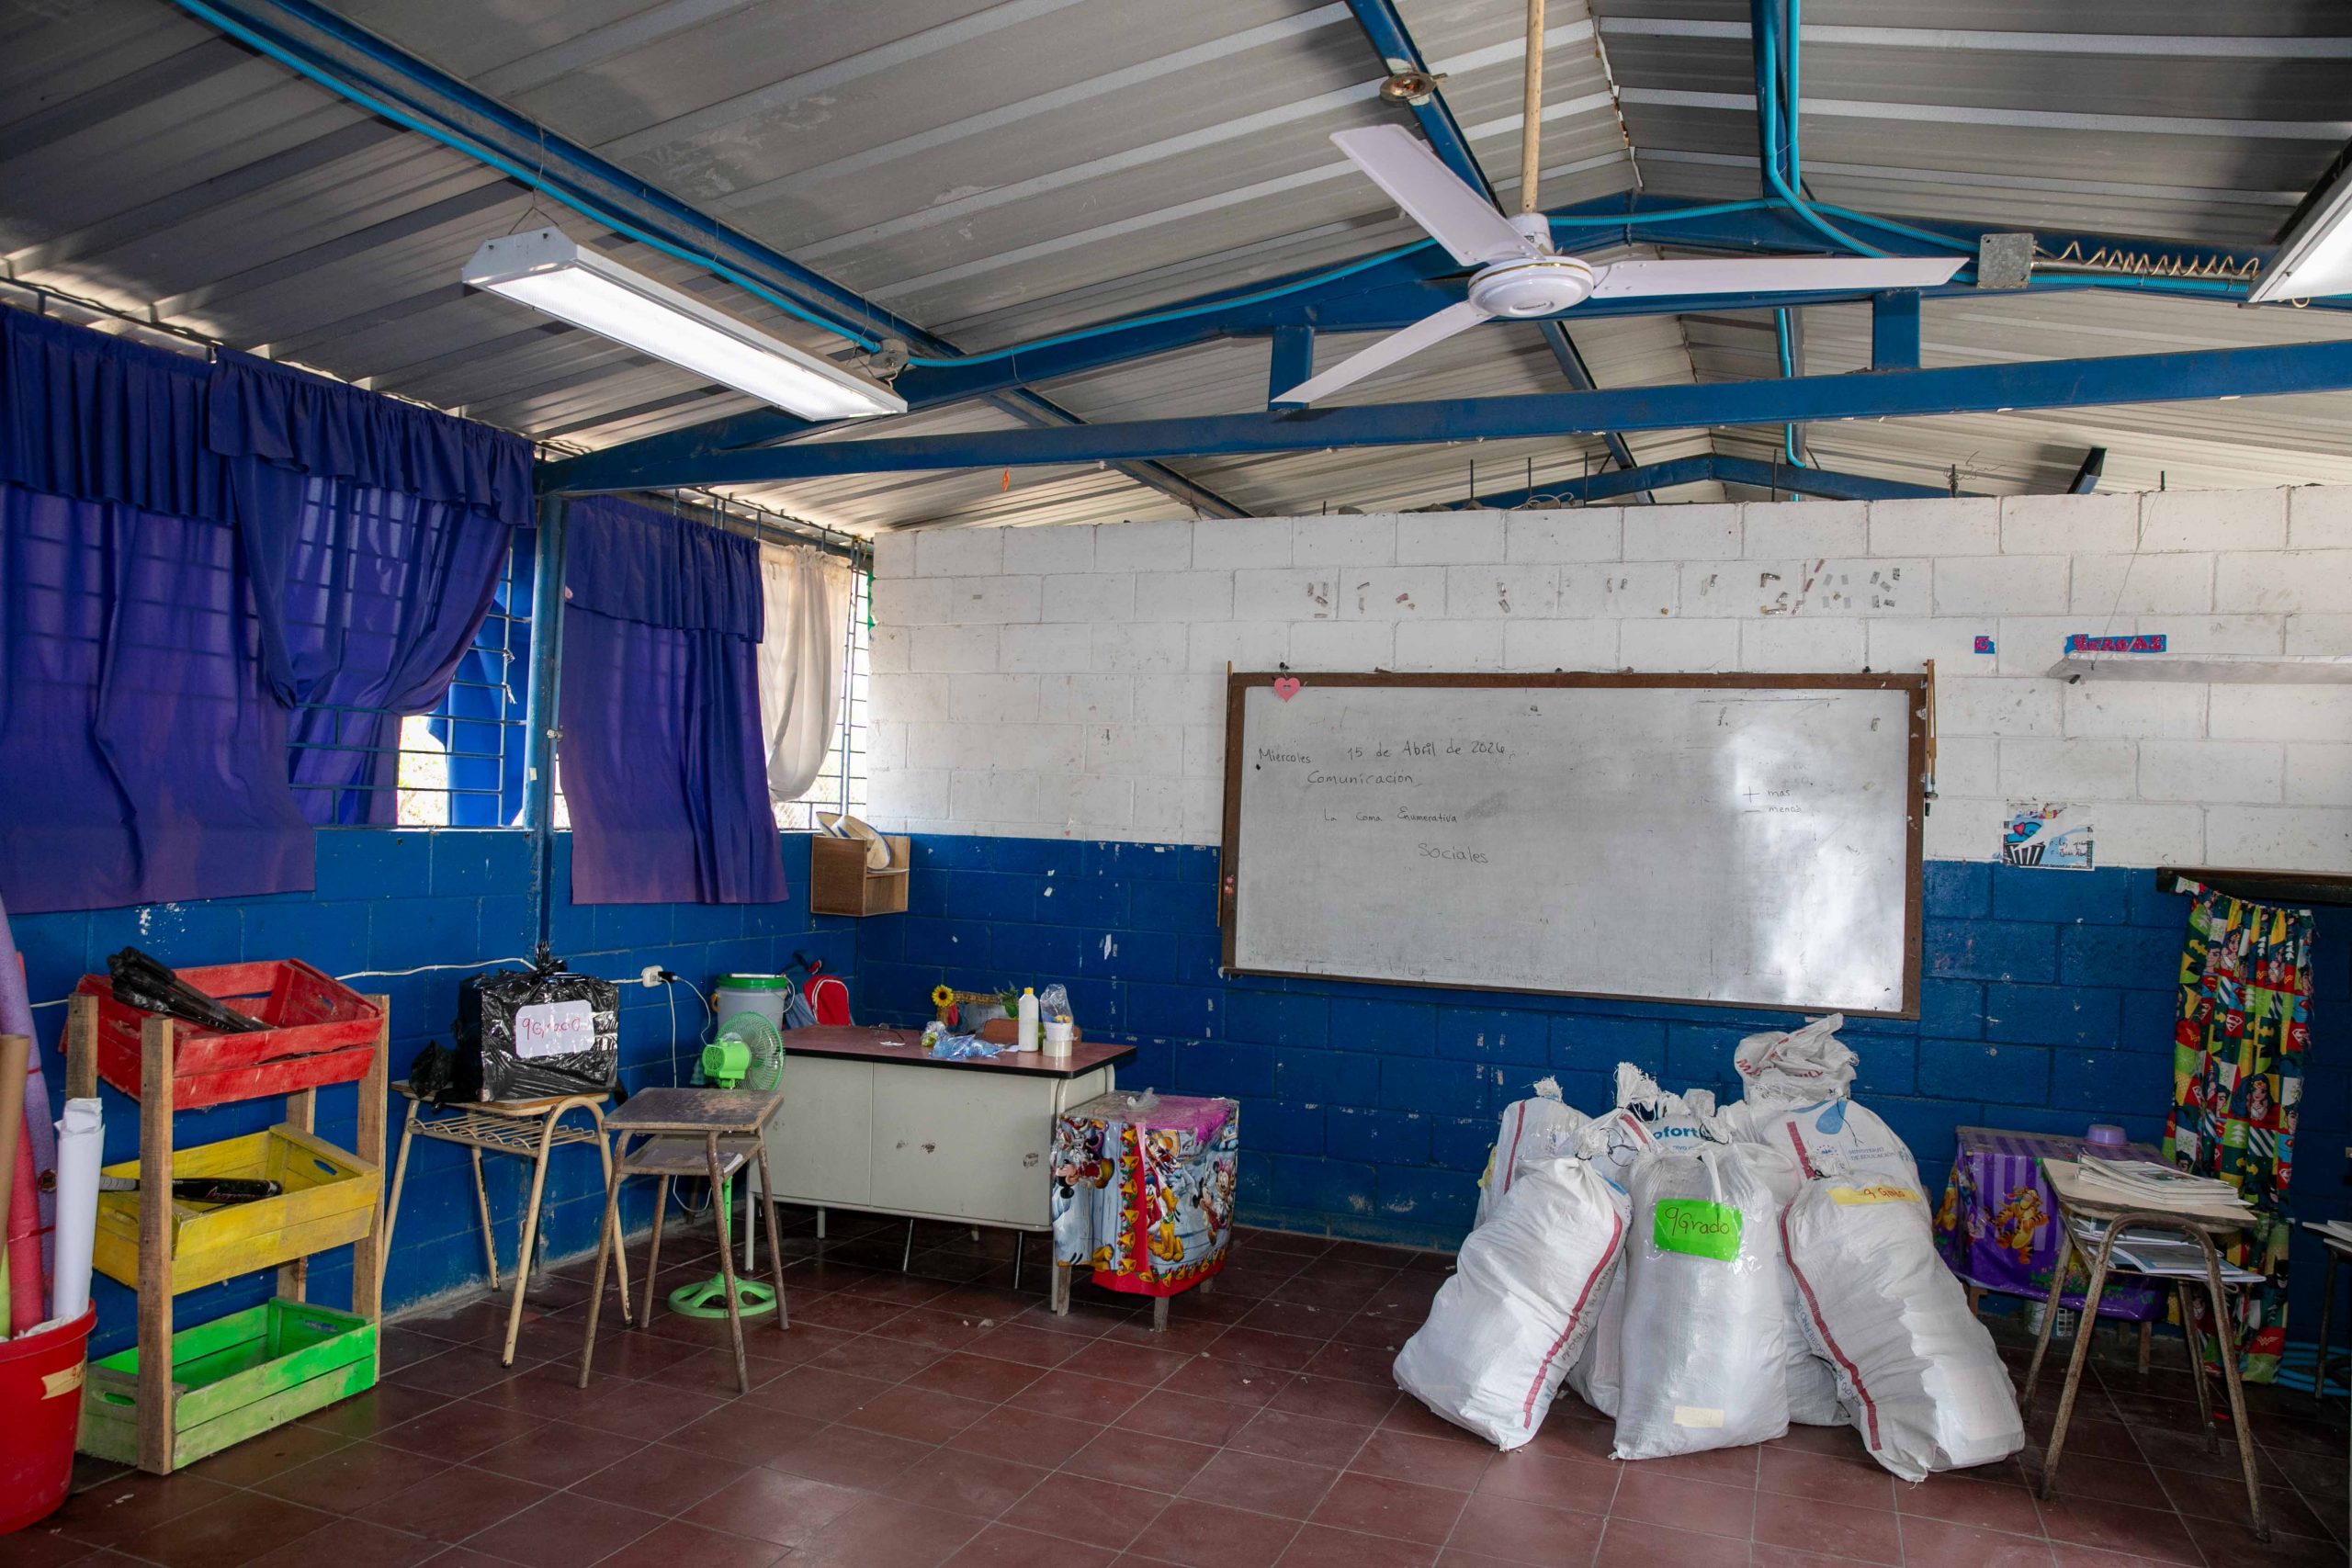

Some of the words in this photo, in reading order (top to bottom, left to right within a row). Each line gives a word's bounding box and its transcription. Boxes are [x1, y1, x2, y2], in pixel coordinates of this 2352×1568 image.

[1346, 747, 1363, 761] 15
[1375, 742, 1391, 757] de
[1402, 740, 1436, 757] Abril
[1446, 738, 1462, 754] de
[1324, 807, 1337, 821] La
[1396, 806, 1457, 823] Enumerativa
[1418, 842, 1488, 863] Sociales
